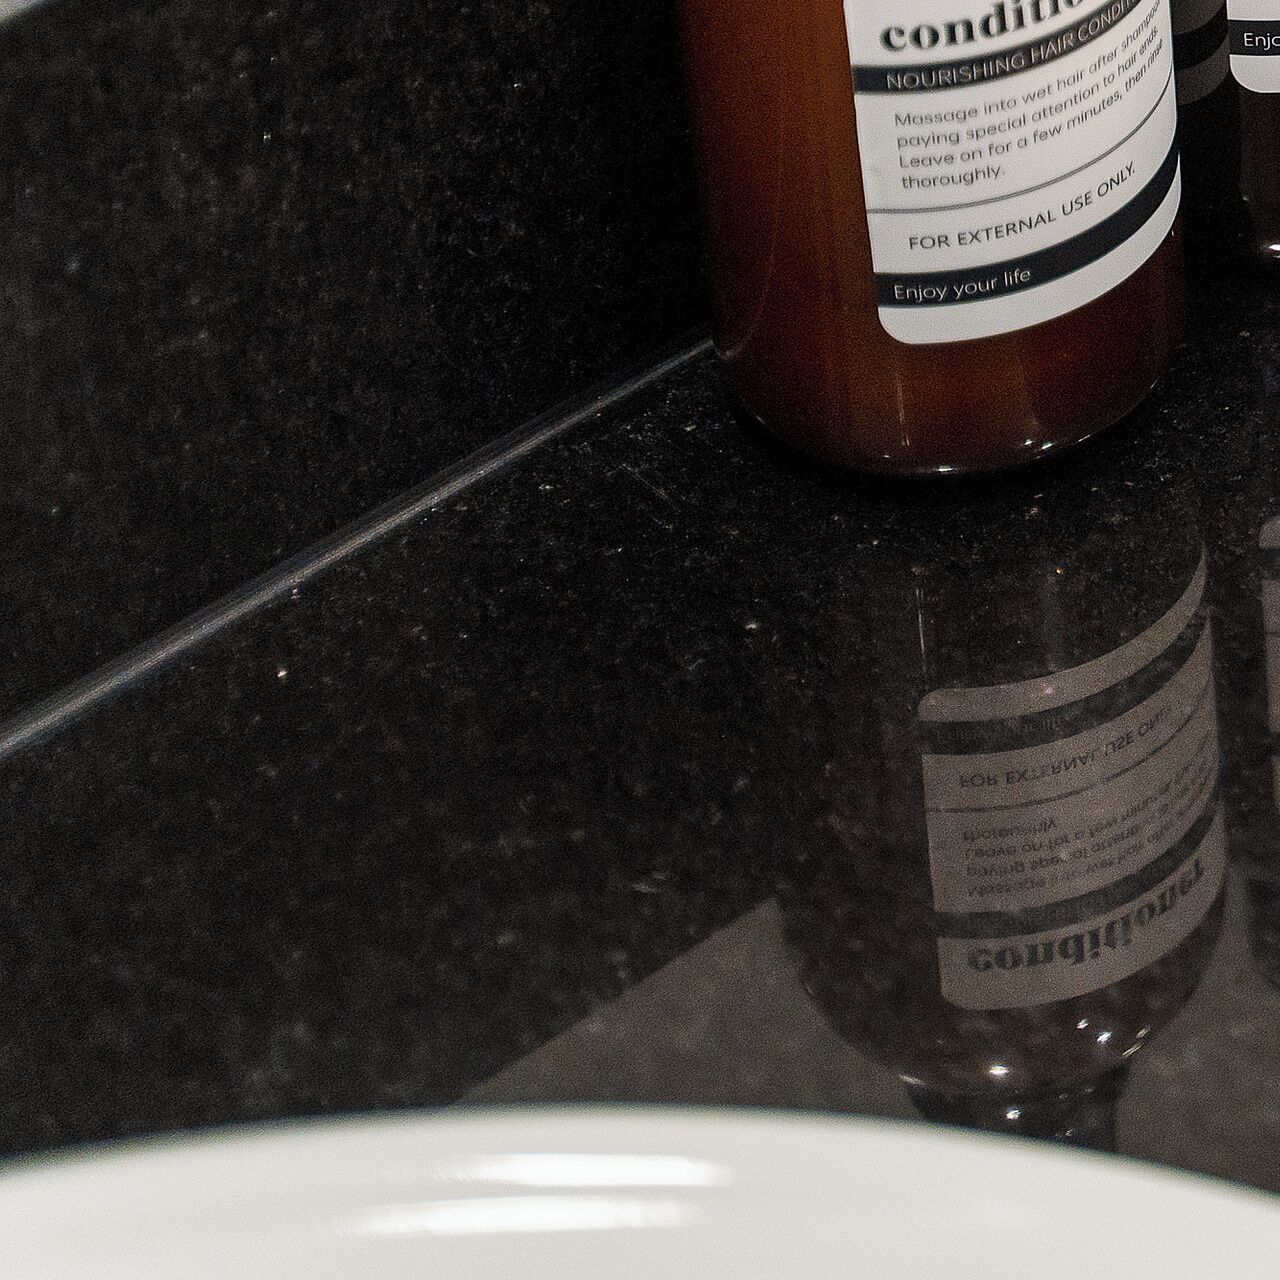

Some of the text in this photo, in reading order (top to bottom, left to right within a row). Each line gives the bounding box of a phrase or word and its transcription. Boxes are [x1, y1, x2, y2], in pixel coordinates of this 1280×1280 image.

[885, 52, 1026, 91] NOURISHING
[1031, 32, 1076, 64] HAIR
[894, 106, 978, 128] Massage
[984, 96, 1017, 116] into
[1022, 84, 1054, 108] wet
[1057, 69, 1085, 92] hair
[1089, 45, 1118, 75] after
[897, 130, 961, 152] paying
[966, 114, 1027, 145] special
[1032, 85, 1100, 124] attention
[1103, 72, 1116, 87] to
[1118, 51, 1138, 78] hair
[899, 149, 955, 170] Leave
[960, 149, 983, 163] on
[987, 139, 1012, 159] for
[1017, 137, 1028, 150] a
[1032, 122, 1063, 146] few
[1067, 89, 1122, 132] minutes,
[1125, 63, 1148, 93] then
[901, 164, 1006, 194] thoroughly.
[908, 160, 1137, 251] FOR EXTERNAL USE ONLY.
[894, 266, 1032, 304] Enjoy your life
